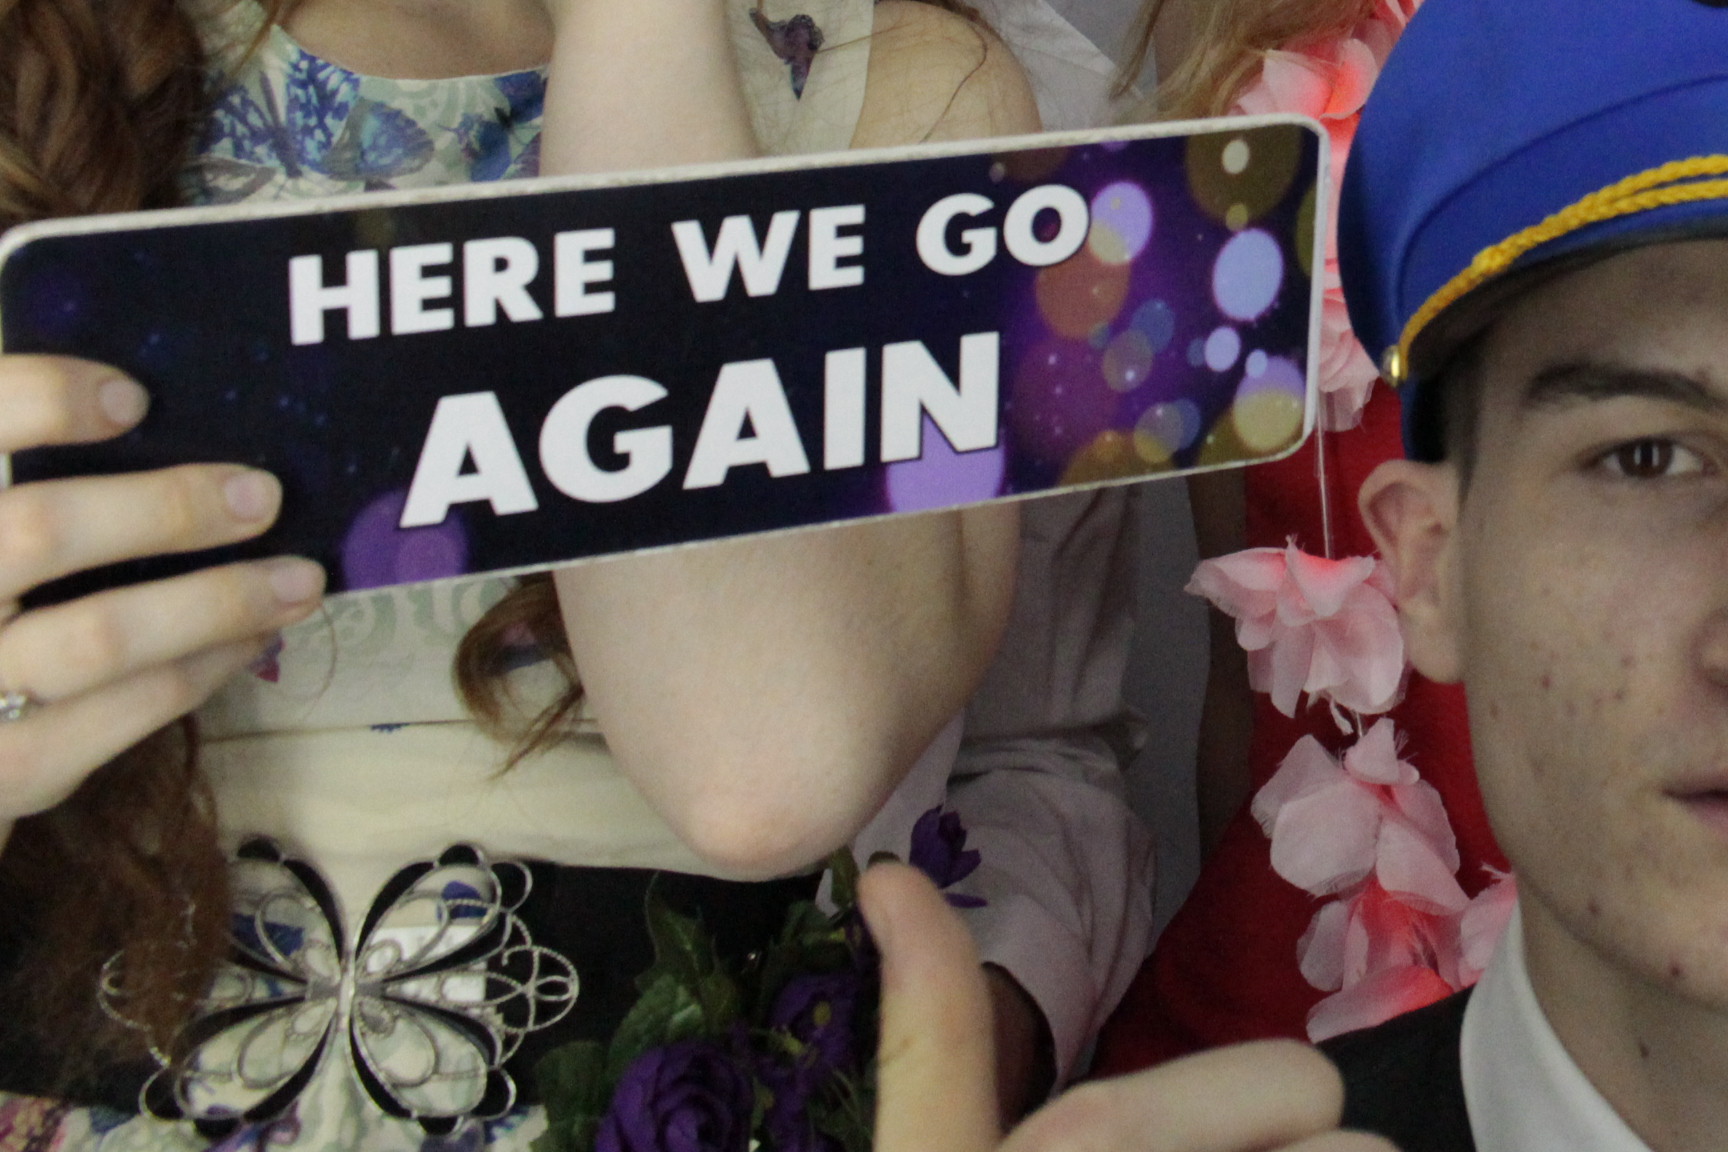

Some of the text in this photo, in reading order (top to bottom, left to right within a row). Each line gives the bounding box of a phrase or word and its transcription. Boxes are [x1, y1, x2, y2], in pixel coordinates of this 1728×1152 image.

[289, 184, 1091, 345] HERE WE GO
[400, 331, 1000, 528] AGAIN
